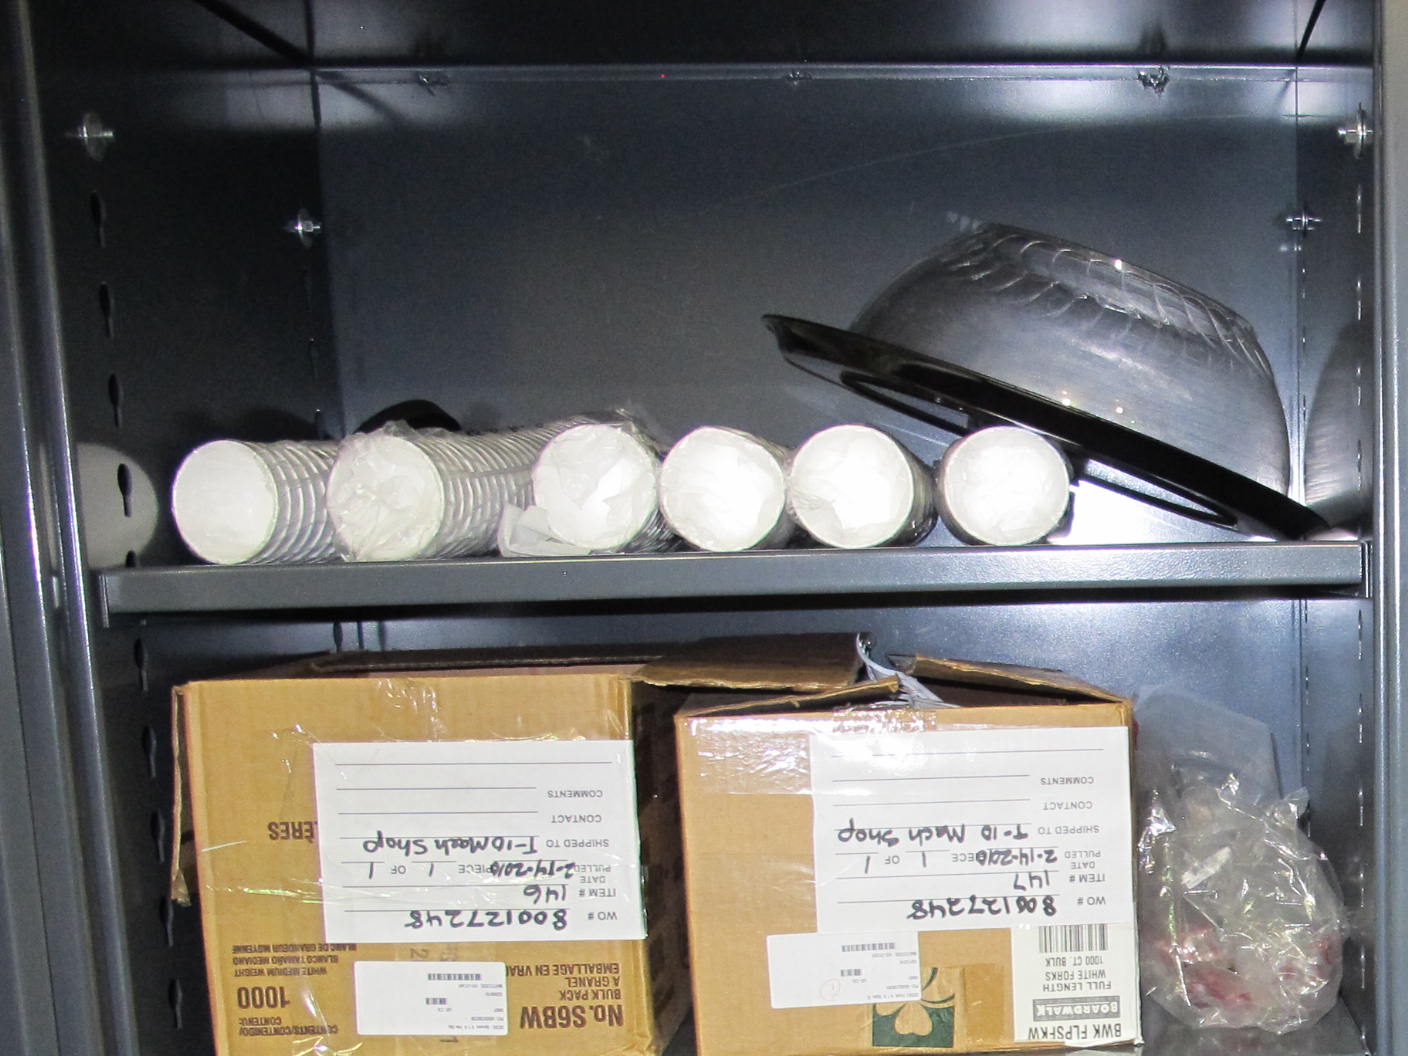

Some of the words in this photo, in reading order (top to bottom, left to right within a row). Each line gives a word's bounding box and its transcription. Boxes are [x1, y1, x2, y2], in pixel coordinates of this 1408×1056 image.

[1040, 776, 1094, 785] COMMENTS
[547, 789, 603, 798] COMMENTS
[1043, 801, 1093, 810] CONTACT
[551, 814, 602, 823] CONTACT
[267, 821, 317, 844] ÈRES
[837, 818, 899, 847] Shop
[1038, 826, 1051, 835] TO
[1055, 825, 1100, 834] SHIPPED
[363, 831, 428, 857] Shop
[491, 836, 538, 855] T-10
[545, 839, 560, 848] TO
[563, 839, 609, 848] SHIPPED
[921, 851, 927, 868] 1
[1064, 850, 1101, 859] PULLED
[864, 856, 871, 874] 1
[884, 855, 900, 865] OF
[391, 865, 407, 875] OF
[428, 862, 434, 877] 1
[458, 864, 492, 874] PIECE
[574, 864, 611, 873] PULLED
[1070, 861, 1095, 870] DATE
[368, 862, 374, 880] 1
[580, 875, 606, 884] DATE
[1013, 870, 1050, 892] 147
[1079, 873, 1105, 883] ITEM
[523, 884, 566, 905] 146
[588, 887, 616, 897] ITEM
[1087, 896, 1105, 905] WO
[906, 894, 1056, 920] 800127248
[404, 909, 567, 931] 800127248
[597, 911, 617, 920] WO
[233, 956, 270, 965] MEDIANO
[307, 955, 338, 964] BLANCO
[1044, 956, 1066, 967] BULK
[1085, 955, 1103, 965] 1000
[234, 968, 265, 977] WEIGHT
[267, 967, 300, 976] MEDIUM
[300, 967, 327, 976] WHITE
[535, 964, 550, 976] EN
[551, 963, 619, 975] EMBALLAGE
[1044, 971, 1074, 981] FORKS
[1077, 969, 1106, 980] WHITE
[564, 976, 610, 988] GRANEL
[612, 975, 620, 987] A
[1086, 981, 1111, 990] FULL
[1042, 982, 1082, 992] LENGTH
[237, 986, 291, 1009] 1000
[559, 990, 589, 1001] PACK
[591, 988, 621, 1000] BULK
[1036, 1001, 1118, 1016] BOARDWALK
[1092, 1023, 1121, 1038] BWK
